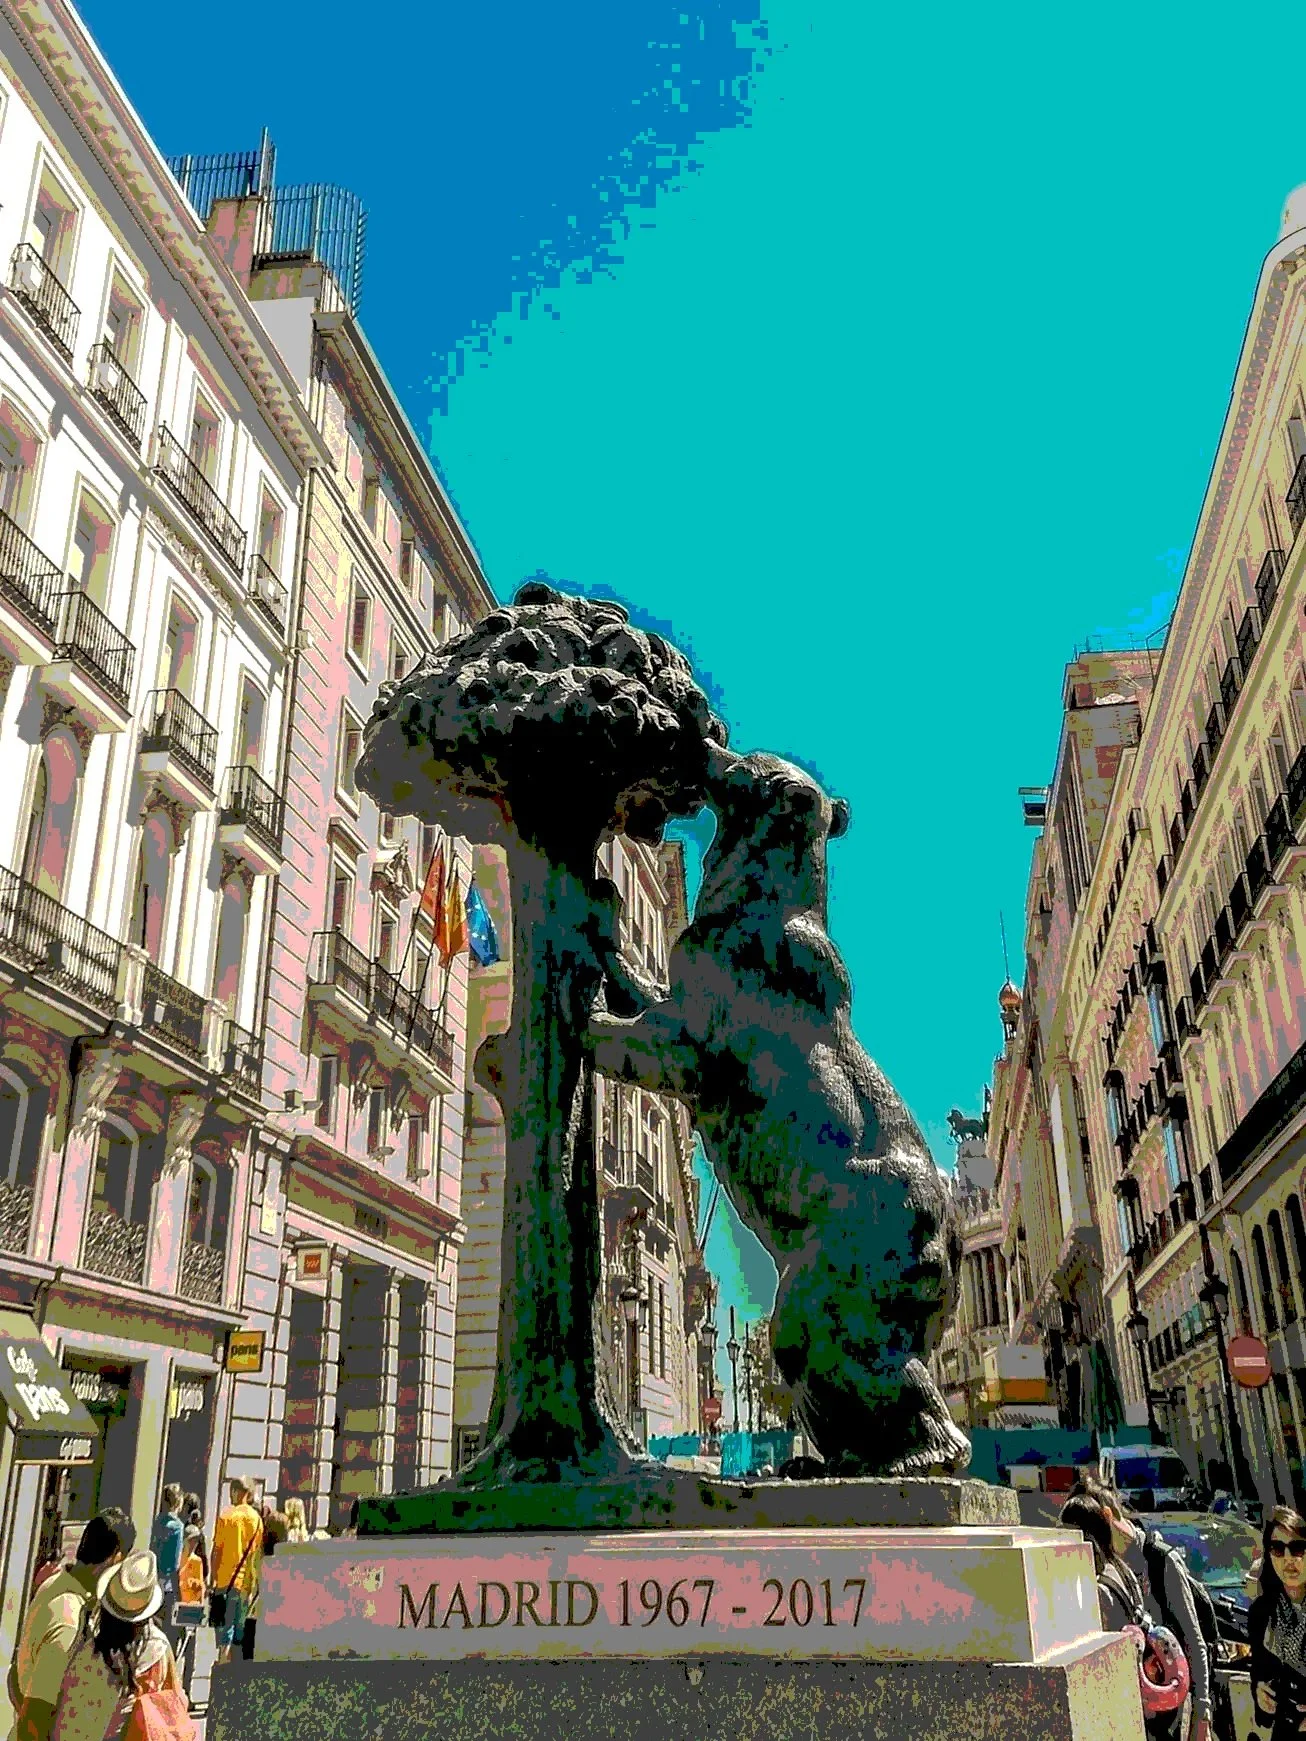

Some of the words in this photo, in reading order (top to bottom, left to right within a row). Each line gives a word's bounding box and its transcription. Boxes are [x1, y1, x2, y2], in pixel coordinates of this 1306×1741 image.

[15, 1382, 70, 1421] pans
[397, 1579, 599, 1629] MADRID
[618, 1578, 715, 1627] 1967
[761, 1578, 866, 1627] 2017
